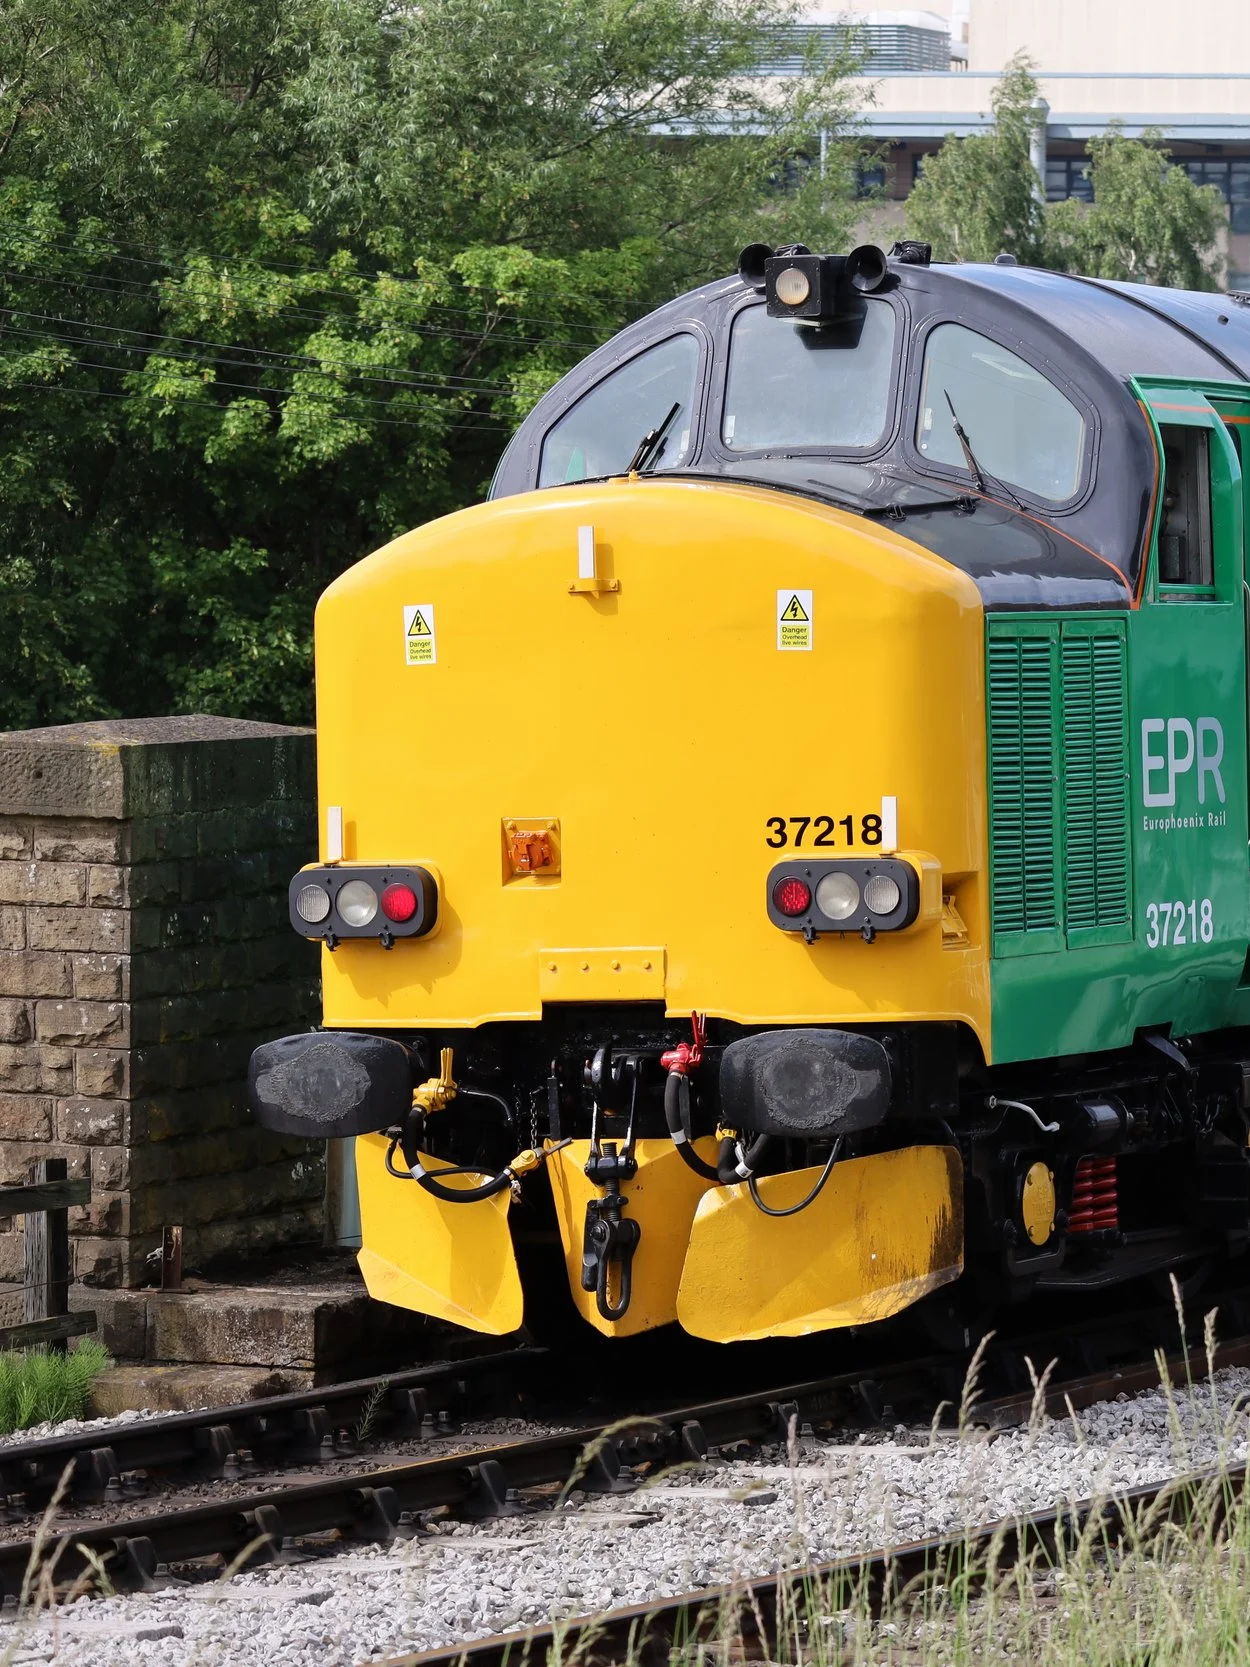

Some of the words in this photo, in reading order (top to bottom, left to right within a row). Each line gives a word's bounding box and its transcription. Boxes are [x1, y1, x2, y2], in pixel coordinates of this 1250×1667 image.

[1141, 717, 1226, 807] EPR
[766, 814, 882, 848] 37218
[1143, 813, 1204, 833] Europhoenix
[1208, 811, 1226, 827] Rail
[1145, 898, 1214, 949] 37218
